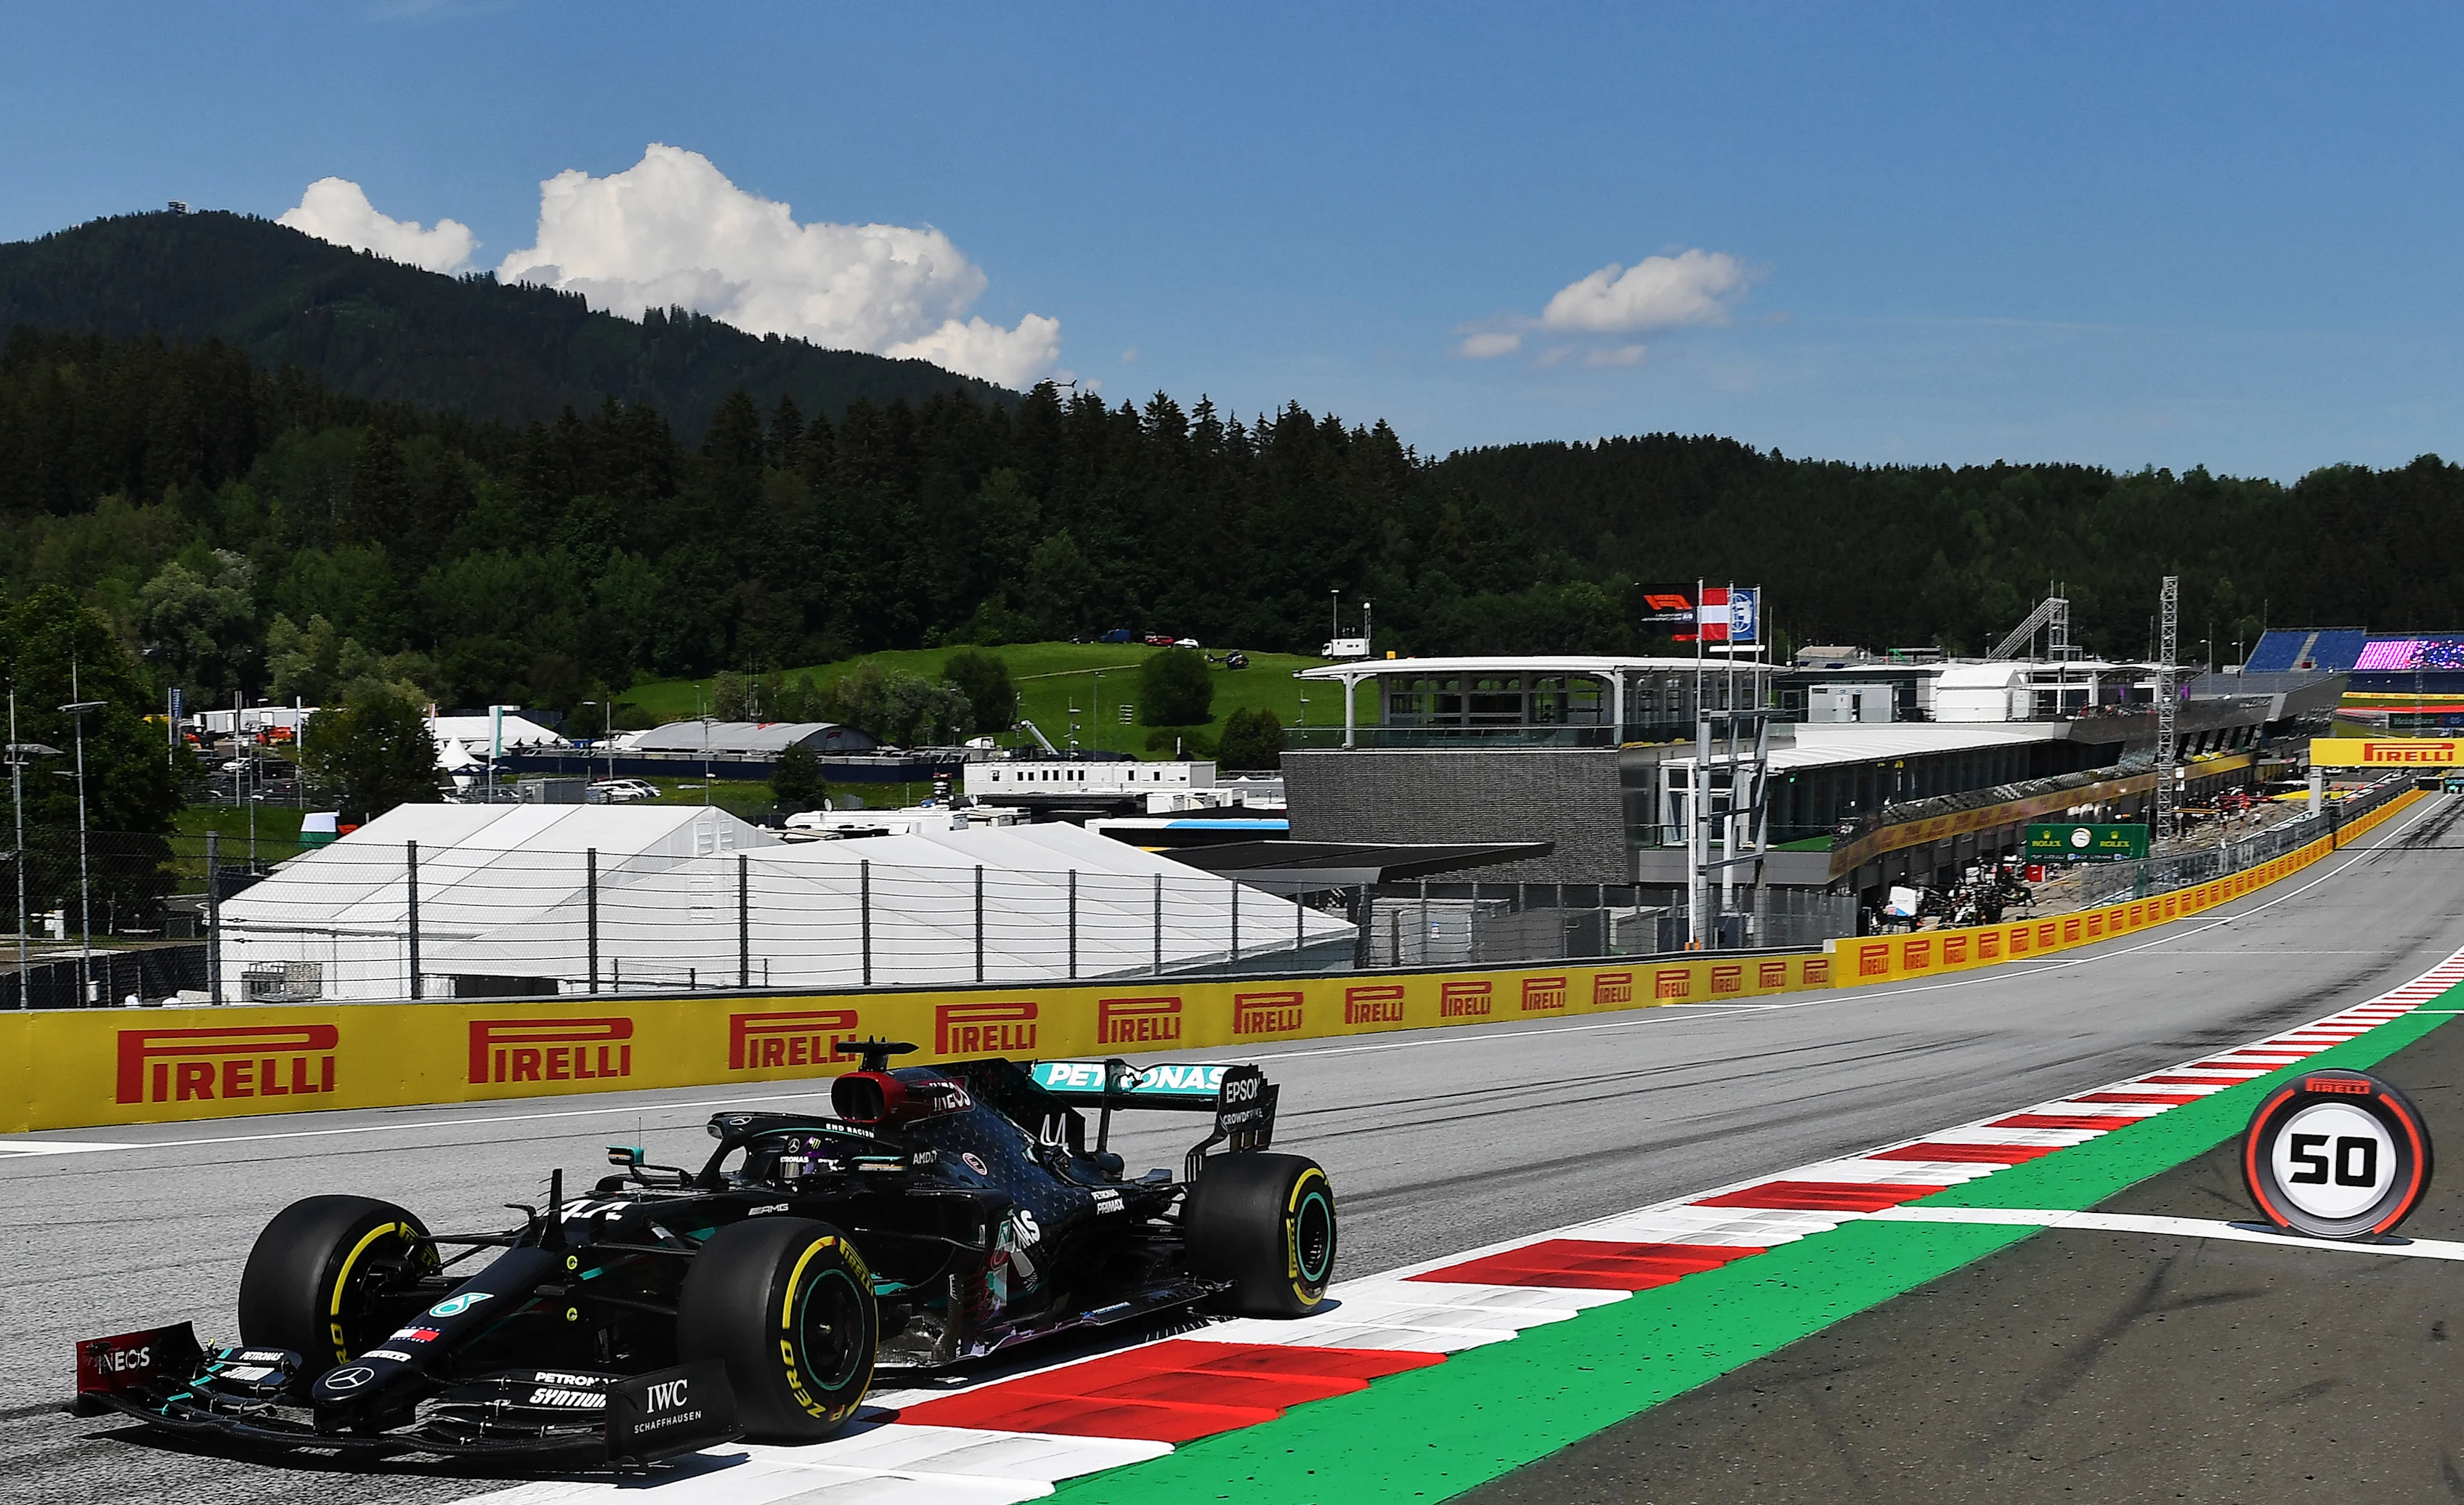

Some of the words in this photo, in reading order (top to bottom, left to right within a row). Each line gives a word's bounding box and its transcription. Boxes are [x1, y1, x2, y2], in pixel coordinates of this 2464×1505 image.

[2364, 743, 2455, 762] PIRELLI
[1345, 985, 1405, 1024] PIRELLI
[1440, 981, 1492, 1017] PIRELLI
[1522, 977, 1567, 1011] PIRELLI
[1593, 973, 1632, 1005] PIRELLI
[935, 1002, 1039, 1055] PIRELLI
[1098, 997, 1183, 1044] PIRELLI
[1233, 991, 1304, 1034] PIRELLI
[469, 1018, 633, 1084] PIRELLI
[729, 1010, 859, 1070] PIRELLI
[116, 1024, 339, 1104] PIRELLI
[2305, 1077, 2371, 1095] PIRELLI
[846, 1127, 875, 1138] RACISM
[2288, 1133, 2378, 1188] 50
[761, 1204, 789, 1214] AMG
[1097, 1197, 1124, 1215] PRIMAX
[838, 1237, 874, 1297] PIRELLI
[238, 1351, 284, 1361] PETRONAS
[535, 1371, 618, 1387] PETRON
[647, 1379, 688, 1414] IWC
[780, 1339, 827, 1419] ZERO
[633, 1410, 702, 1434] SCHAFFHAUSEN
